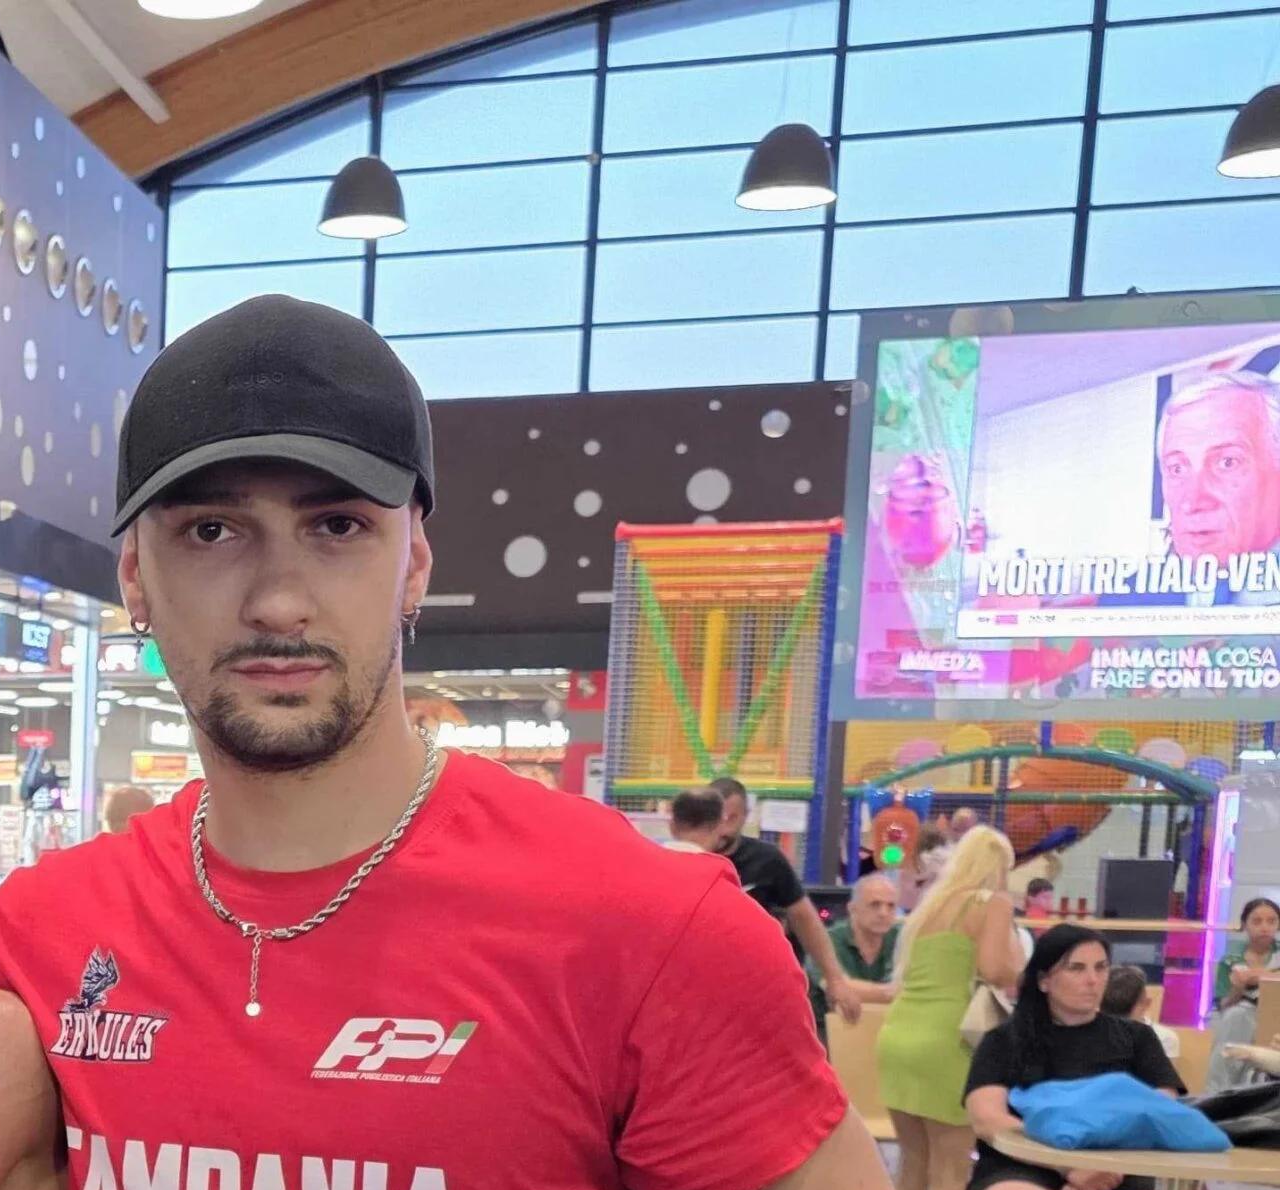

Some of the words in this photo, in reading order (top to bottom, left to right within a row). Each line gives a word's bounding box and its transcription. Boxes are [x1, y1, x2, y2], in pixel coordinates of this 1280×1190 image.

[978, 557, 1070, 597] MORTI
[1091, 647, 1212, 669] IMMAGINA
[1215, 647, 1277, 667] COSA
[1090, 669, 1147, 688] FARE
[1151, 669, 1202, 688] CON
[1205, 669, 1228, 688] IL
[1230, 668, 1280, 688] TUO
[52, 1010, 168, 1061] ERKULES
